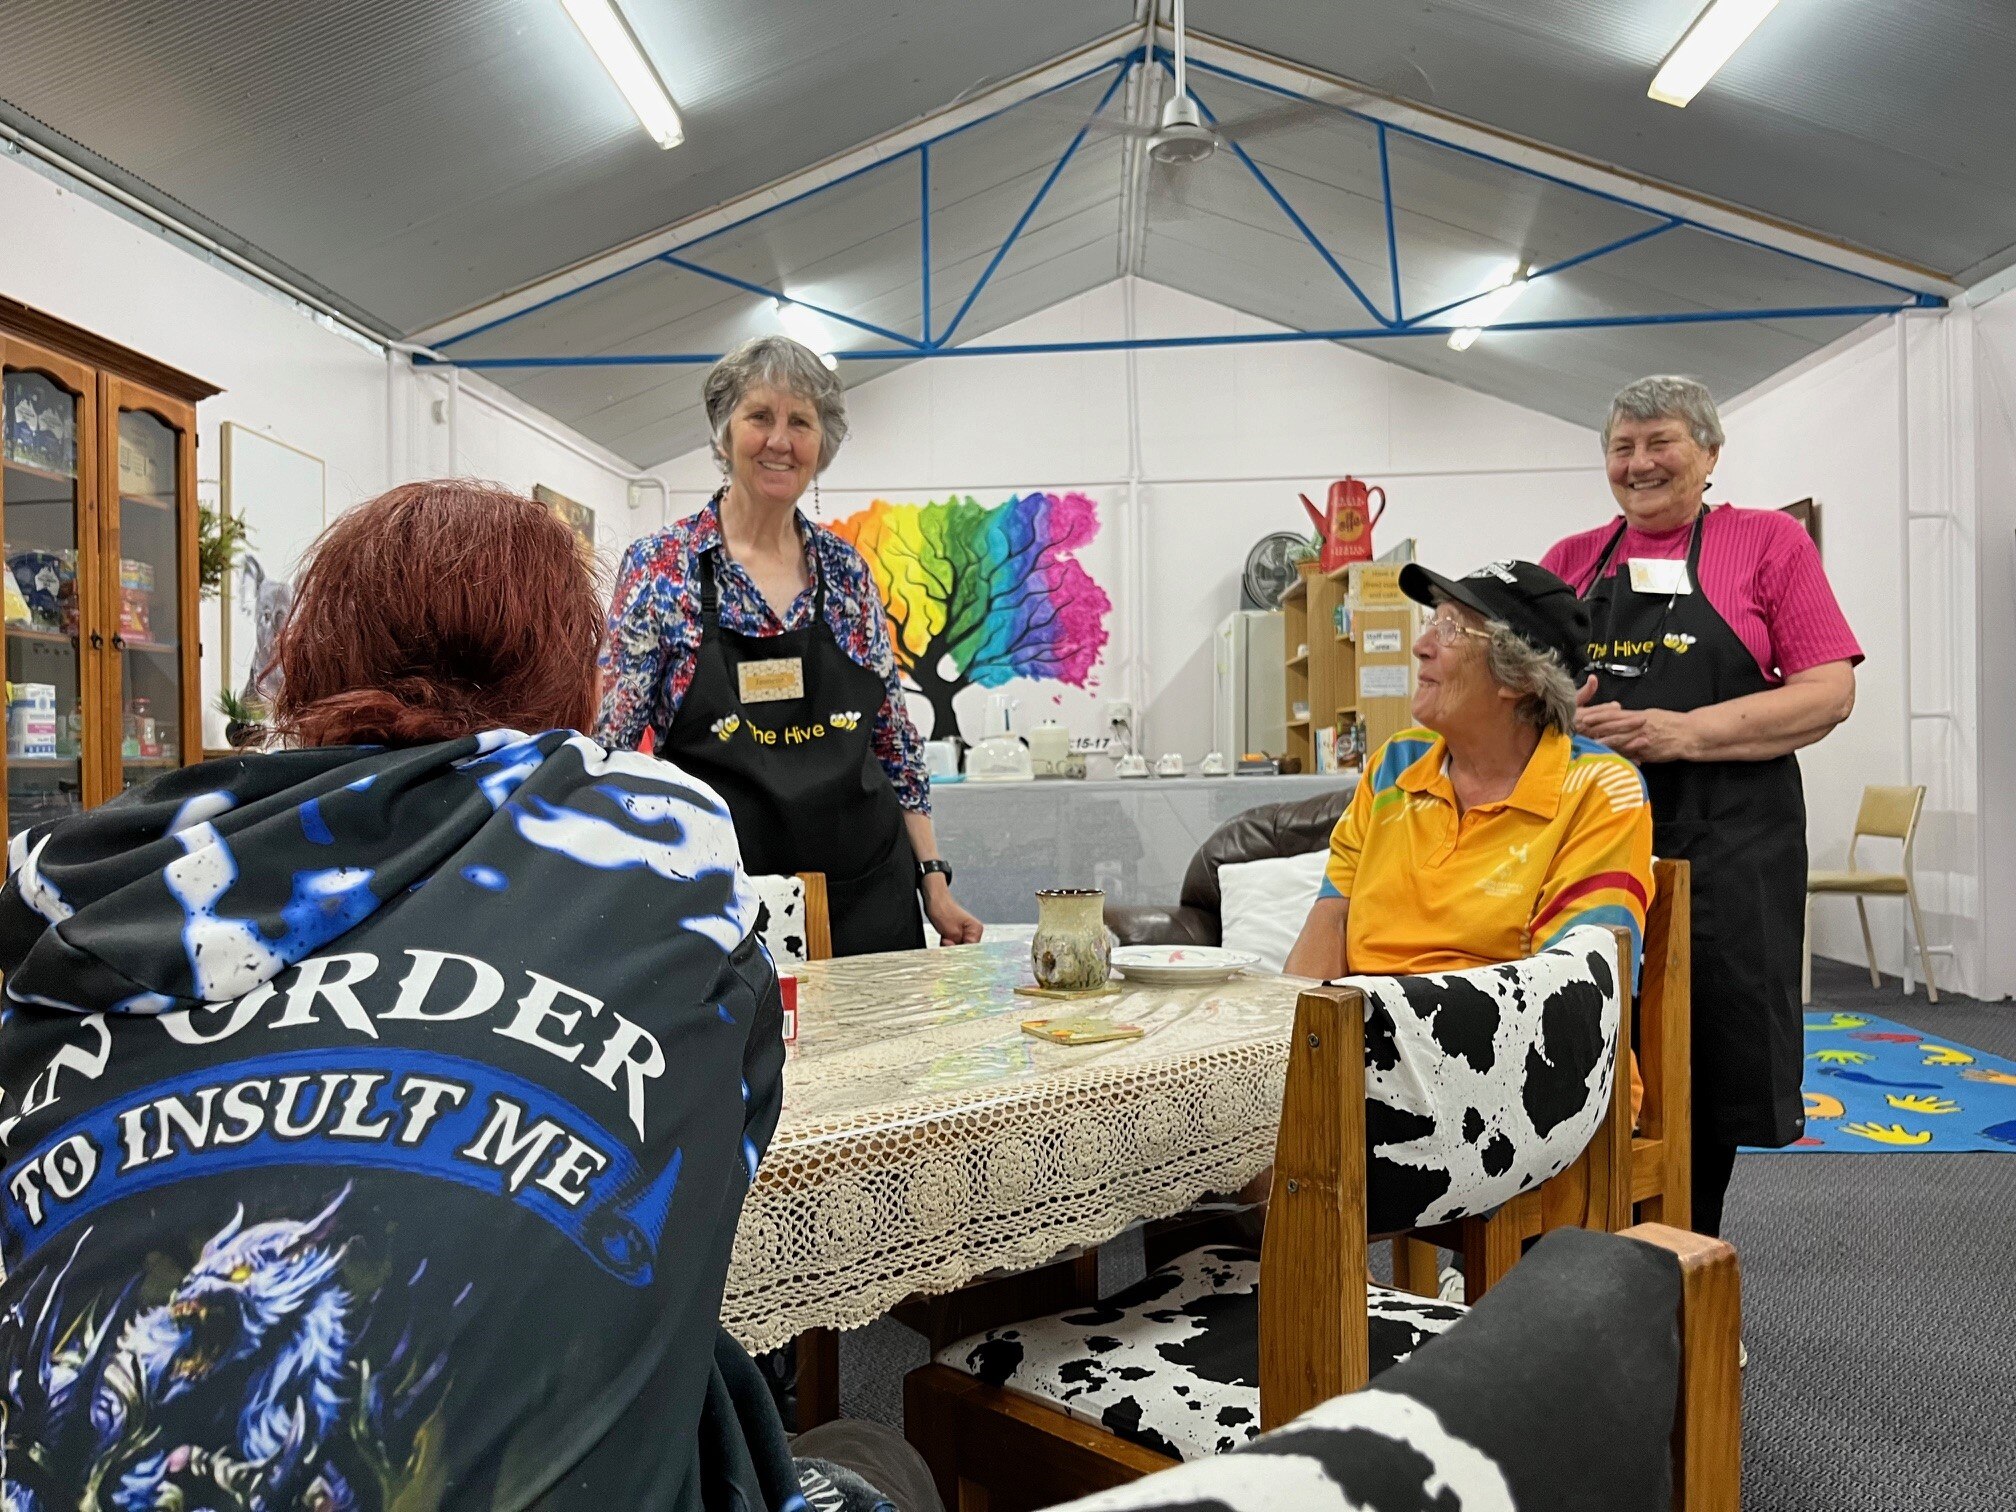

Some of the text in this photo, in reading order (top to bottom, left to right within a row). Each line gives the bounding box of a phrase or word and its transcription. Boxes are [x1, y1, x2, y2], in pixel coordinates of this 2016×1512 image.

[1613, 640, 1654, 657] Hive
[784, 723, 826, 745] Hive
[157, 949, 666, 1143] ORDER
[9, 1074, 607, 1226] TO INSULT ME
